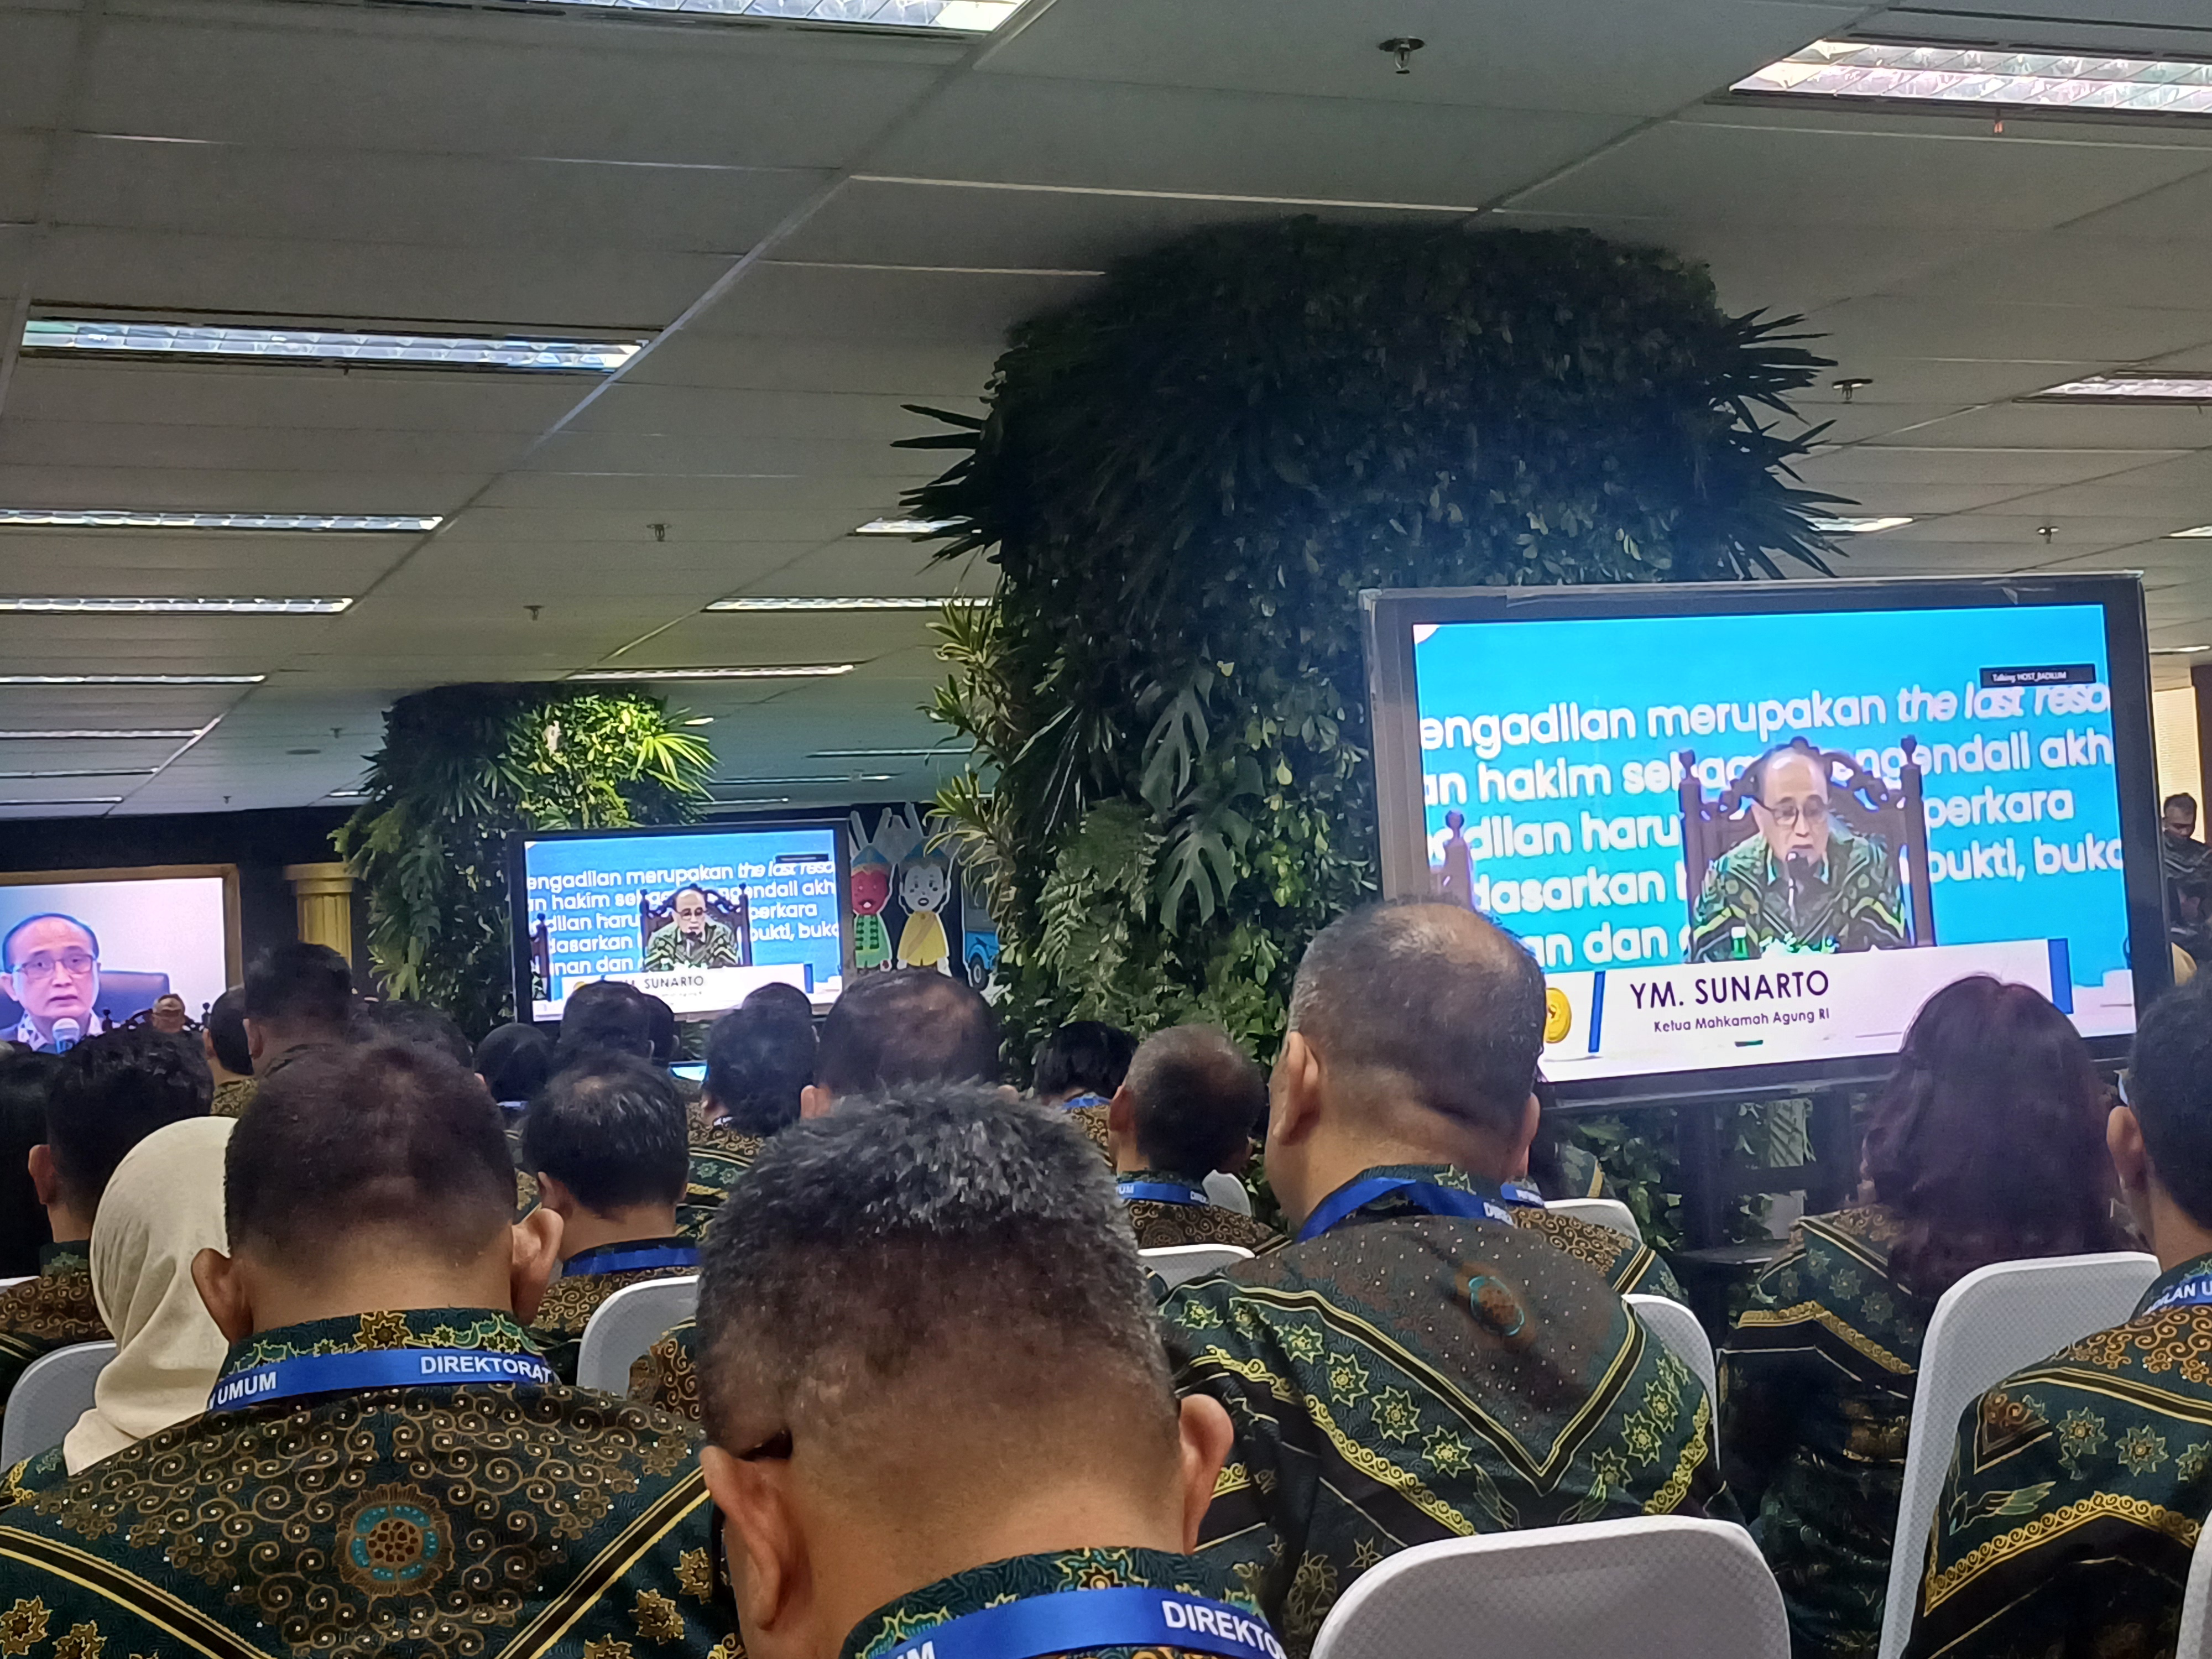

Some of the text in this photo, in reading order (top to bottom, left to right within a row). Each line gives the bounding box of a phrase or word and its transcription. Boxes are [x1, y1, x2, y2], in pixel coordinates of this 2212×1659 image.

[1647, 689, 1887, 742] merupakan
[1897, 684, 1958, 723] the
[1964, 681, 2026, 721] last
[1477, 757, 1611, 804] hakim
[2040, 727, 2112, 768] akh
[626, 864, 733, 886] merupakan
[738, 862, 766, 878] the
[552, 891, 610, 910] hakim
[1583, 922, 1669, 964] dan
[596, 955, 634, 973] dan
[644, 975, 704, 989] SUNARTO
[1630, 969, 1829, 1009] YM. SUNARTO
[1653, 1008, 1830, 1032] Ketua Mahkamah Agung RI
[217, 1371, 276, 1405] UMUM
[421, 1356, 552, 1384] DIREKTORAT
[1162, 1600, 1287, 1659] DIREKTO
